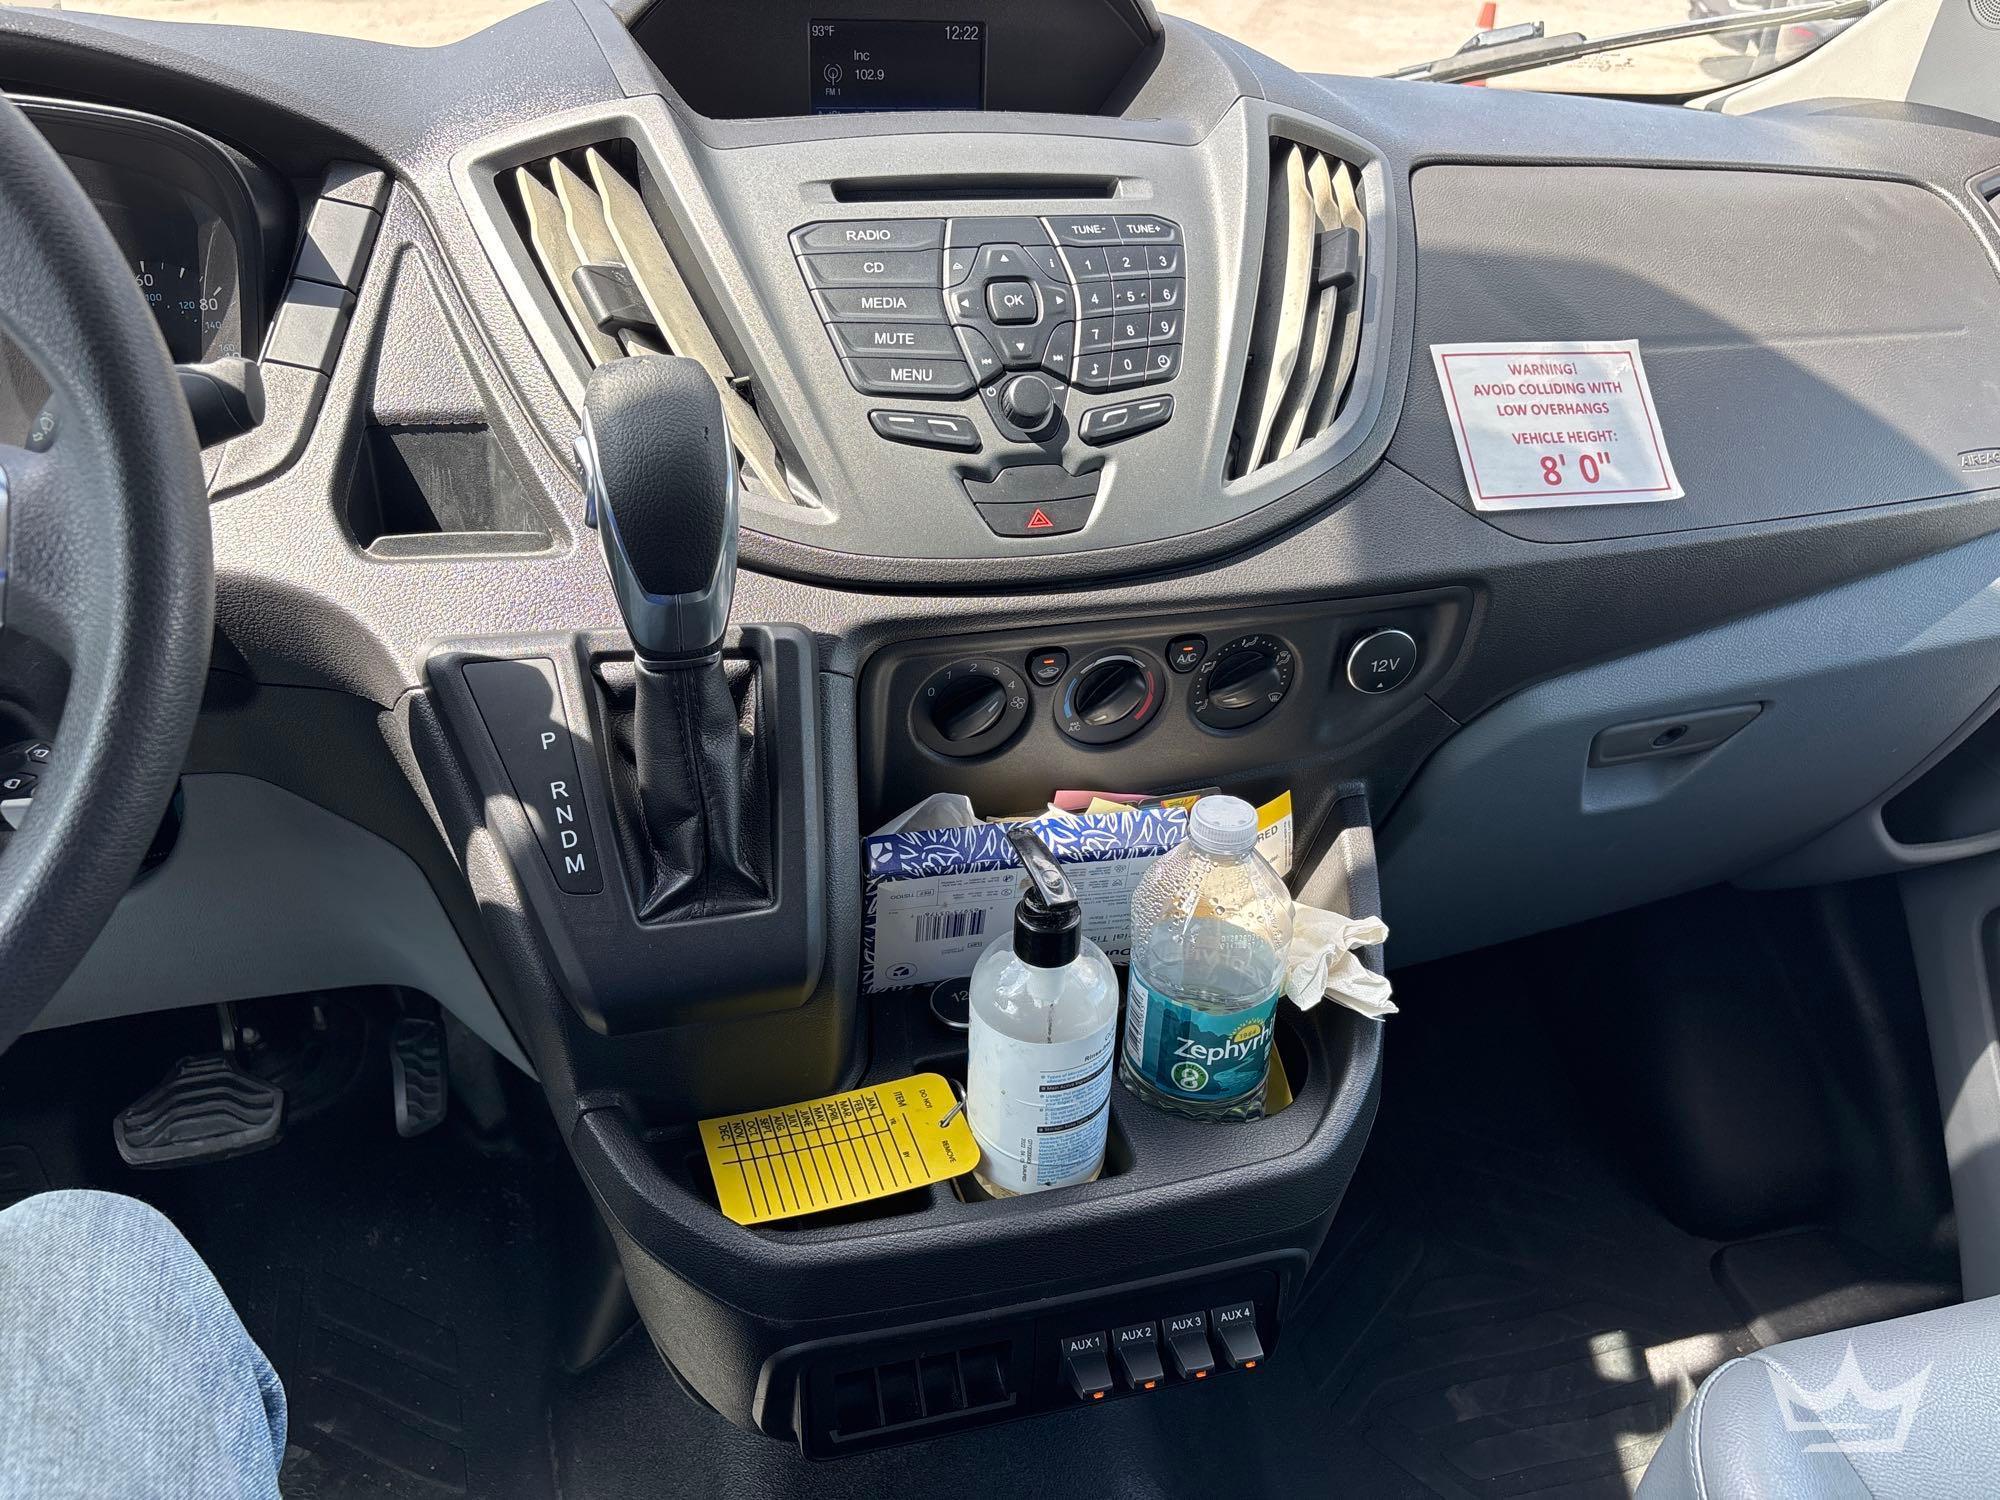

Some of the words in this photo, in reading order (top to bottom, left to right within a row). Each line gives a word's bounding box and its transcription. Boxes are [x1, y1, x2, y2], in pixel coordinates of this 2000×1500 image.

[945, 25, 979, 41] 12:22
[853, 50, 870, 61] Inc
[854, 69, 885, 81] 102.9
[825, 88, 836, 96] FM
[846, 229, 891, 241] RADIO
[1071, 225, 1107, 235] TUNE-
[1126, 223, 1161, 234] TUNE+
[863, 261, 885, 273] CD
[1085, 260, 1092, 271] 1
[1122, 257, 1131, 268] 2
[1159, 255, 1168, 267] 3
[1003, 294, 1025, 307] OK
[1091, 293, 1099, 304] 4
[1126, 290, 1136, 302] 5
[1163, 289, 1172, 300] 6
[178, 301, 195, 310] 120
[199, 298, 218, 311] 80
[861, 297, 908, 309] MEDIA
[205, 321, 222, 330] 140
[1126, 325, 1136, 337] 8
[1161, 321, 1170, 333] 9
[874, 332, 915, 345] MUTE
[1091, 329, 1100, 340] 7
[218, 344, 236, 352] 160
[1123, 359, 1133, 371] 0
[1507, 362, 1578, 376] WARNING!
[890, 368, 933, 381] MENU
[1473, 383, 1516, 397] AVOID
[1518, 382, 1586, 396] COLLIDING
[1586, 380, 1623, 394] WITH
[1496, 404, 1528, 417] LOW
[1530, 402, 1610, 416] OVERHANGS
[1511, 431, 1566, 446] VEHICLE
[1566, 429, 1619, 444] HEIGHT:
[1961, 451, 2000, 468] AIRBAG
[1539, 452, 1567, 487] 8'
[1577, 451, 1612, 484] 0"
[1176, 651, 1198, 665] A/C
[968, 662, 978, 674] 2
[992, 665, 1001, 677] 3
[1370, 657, 1401, 673] 12V
[946, 670, 953, 681] 1
[1006, 679, 1017, 690] 4
[926, 687, 936, 698] 0
[540, 731, 556, 751] P
[550, 781, 569, 800] R
[556, 804, 574, 824] N
[561, 829, 578, 849] D
[1257, 825, 1279, 844] RED
[564, 853, 586, 874] M
[951, 990, 969, 1003] 12
[866, 1095, 877, 1112] JAN.
[893, 1090, 907, 1108] ITEM
[825, 1103, 838, 1123] APRIL
[854, 1099, 864, 1114] FEB.
[786, 1112, 800, 1129] JULY
[799, 1108, 813, 1128] JUNE
[813, 1106, 826, 1123] MAY
[732, 1122, 745, 1140] NOV.
[772, 1116, 785, 1133] AUG.
[918, 1089, 928, 1099] DO
[923, 1097, 934, 1109] NOT
[941, 1139, 957, 1164] REMOVE
[718, 1124, 732, 1142] DEC.
[902, 1151, 910, 1159] BY
[1219, 1310, 1243, 1323] AUX
[1242, 1307, 1251, 1319] 4
[1170, 1320, 1194, 1333] AUX
[1194, 1317, 1203, 1329] 3
[1120, 1329, 1143, 1343] AUX
[1144, 1327, 1152, 1339] 2
[1069, 1339, 1093, 1352] AUX
[1094, 1337, 1101, 1349] 1
